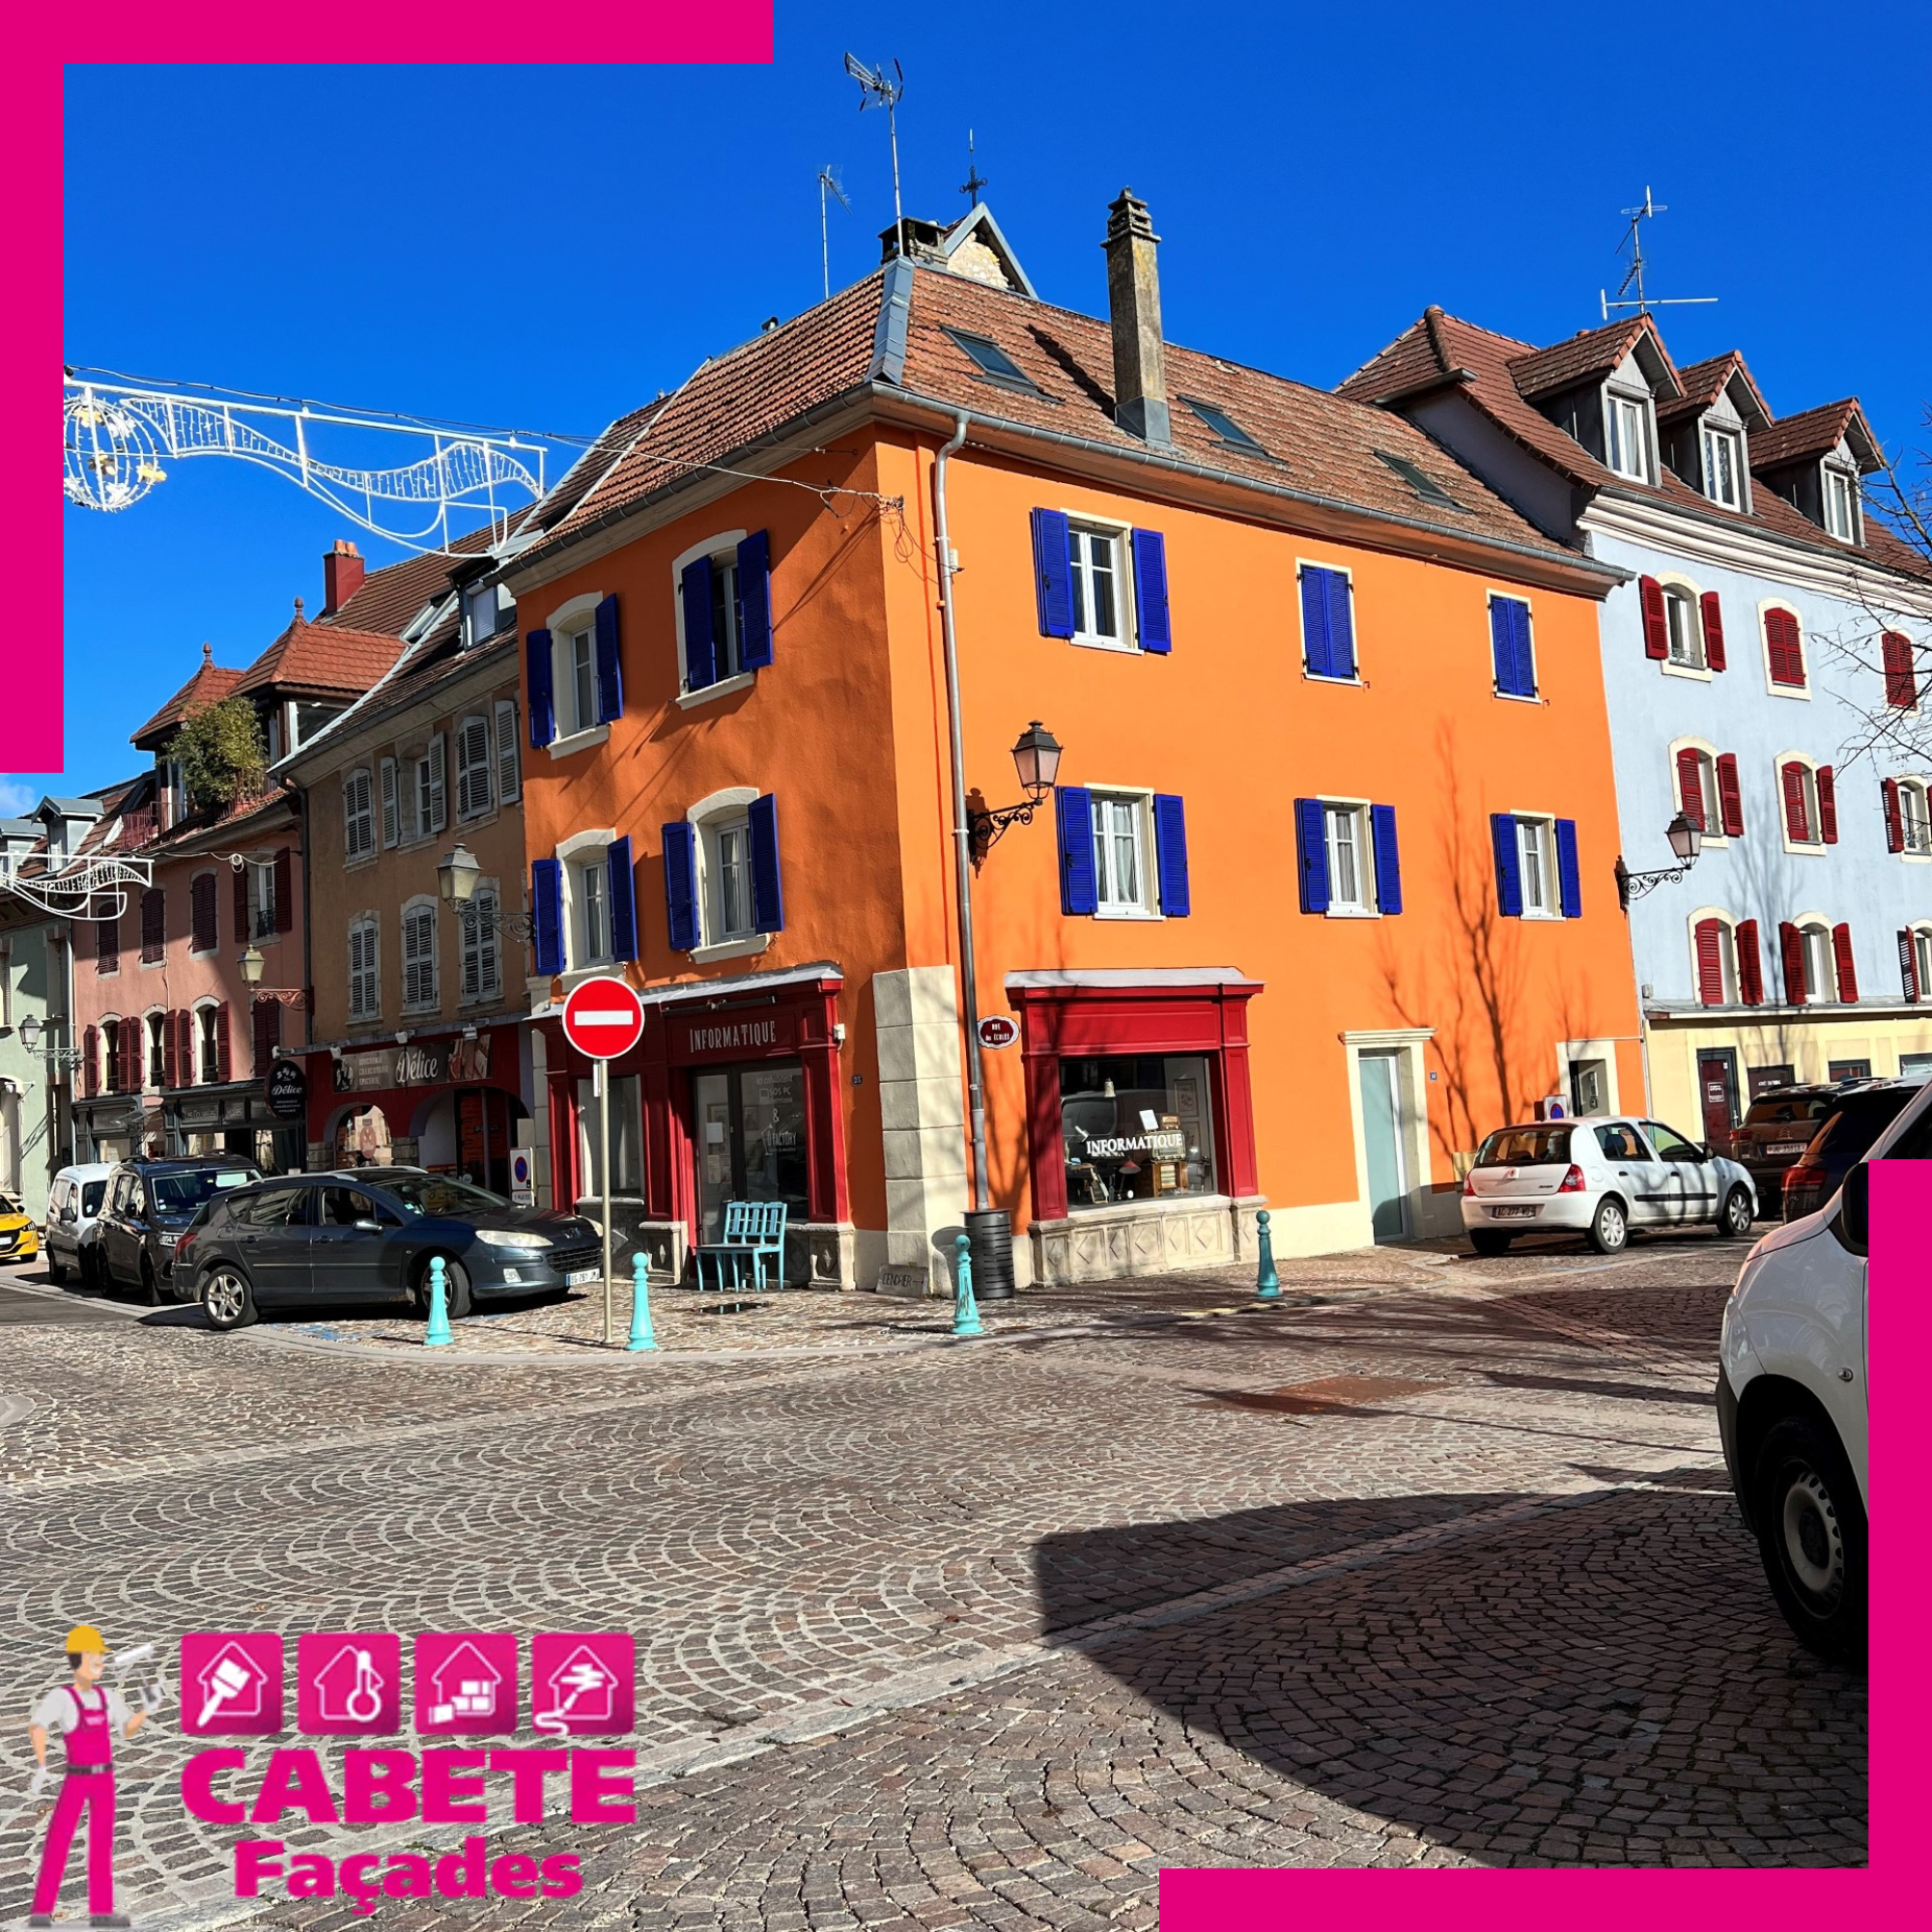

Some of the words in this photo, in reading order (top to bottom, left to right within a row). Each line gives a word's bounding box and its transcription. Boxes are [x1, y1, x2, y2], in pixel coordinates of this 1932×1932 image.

[689, 1020, 777, 1054] INFORMATIQUE
[395, 1048, 439, 1084] Délice
[271, 1084, 303, 1095] Délice
[769, 1087, 781, 1096] SOS
[782, 1086, 791, 1095] PC
[773, 1108, 780, 1123] &
[772, 1131, 797, 1147] FACTORY
[1086, 1133, 1183, 1154] INFORMATIQUE
